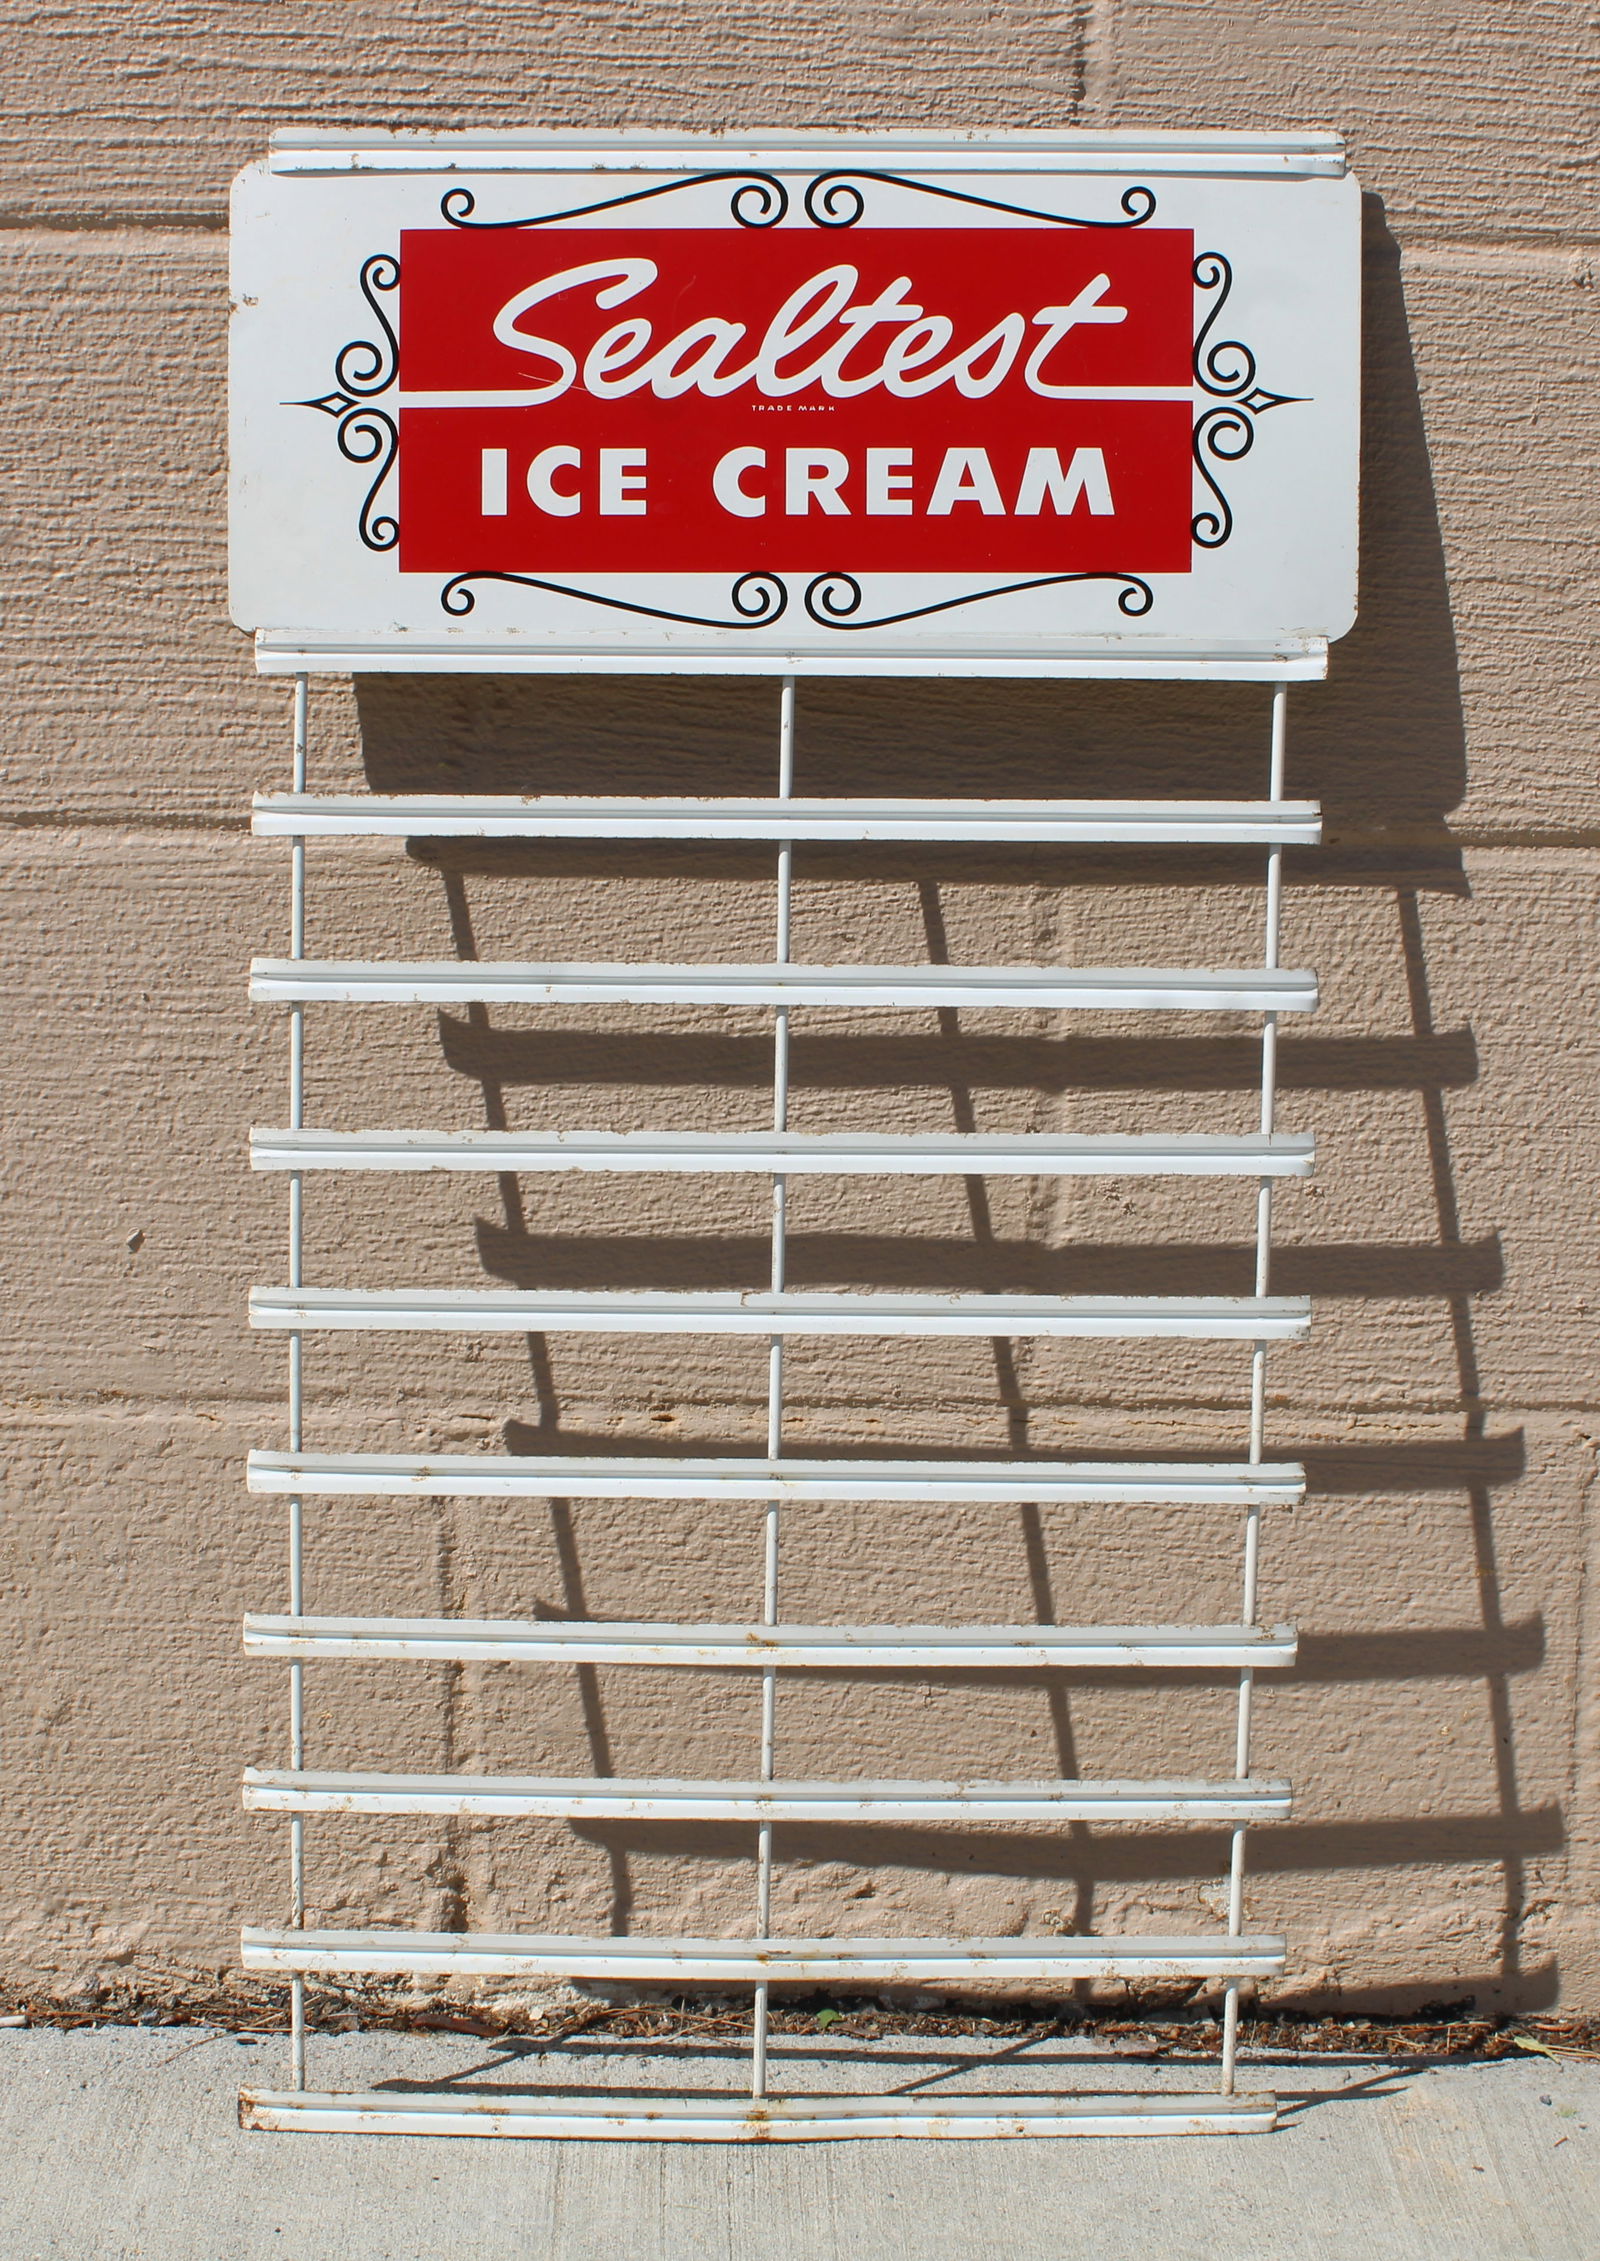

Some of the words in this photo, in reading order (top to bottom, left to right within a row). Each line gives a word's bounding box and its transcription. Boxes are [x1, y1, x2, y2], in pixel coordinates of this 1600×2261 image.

[491, 257, 1128, 408] Sealtest
[751, 404, 793, 412] TRADE
[798, 404, 836, 412] MARK
[481, 445, 648, 518] ICE
[712, 445, 1116, 518] CREAM
